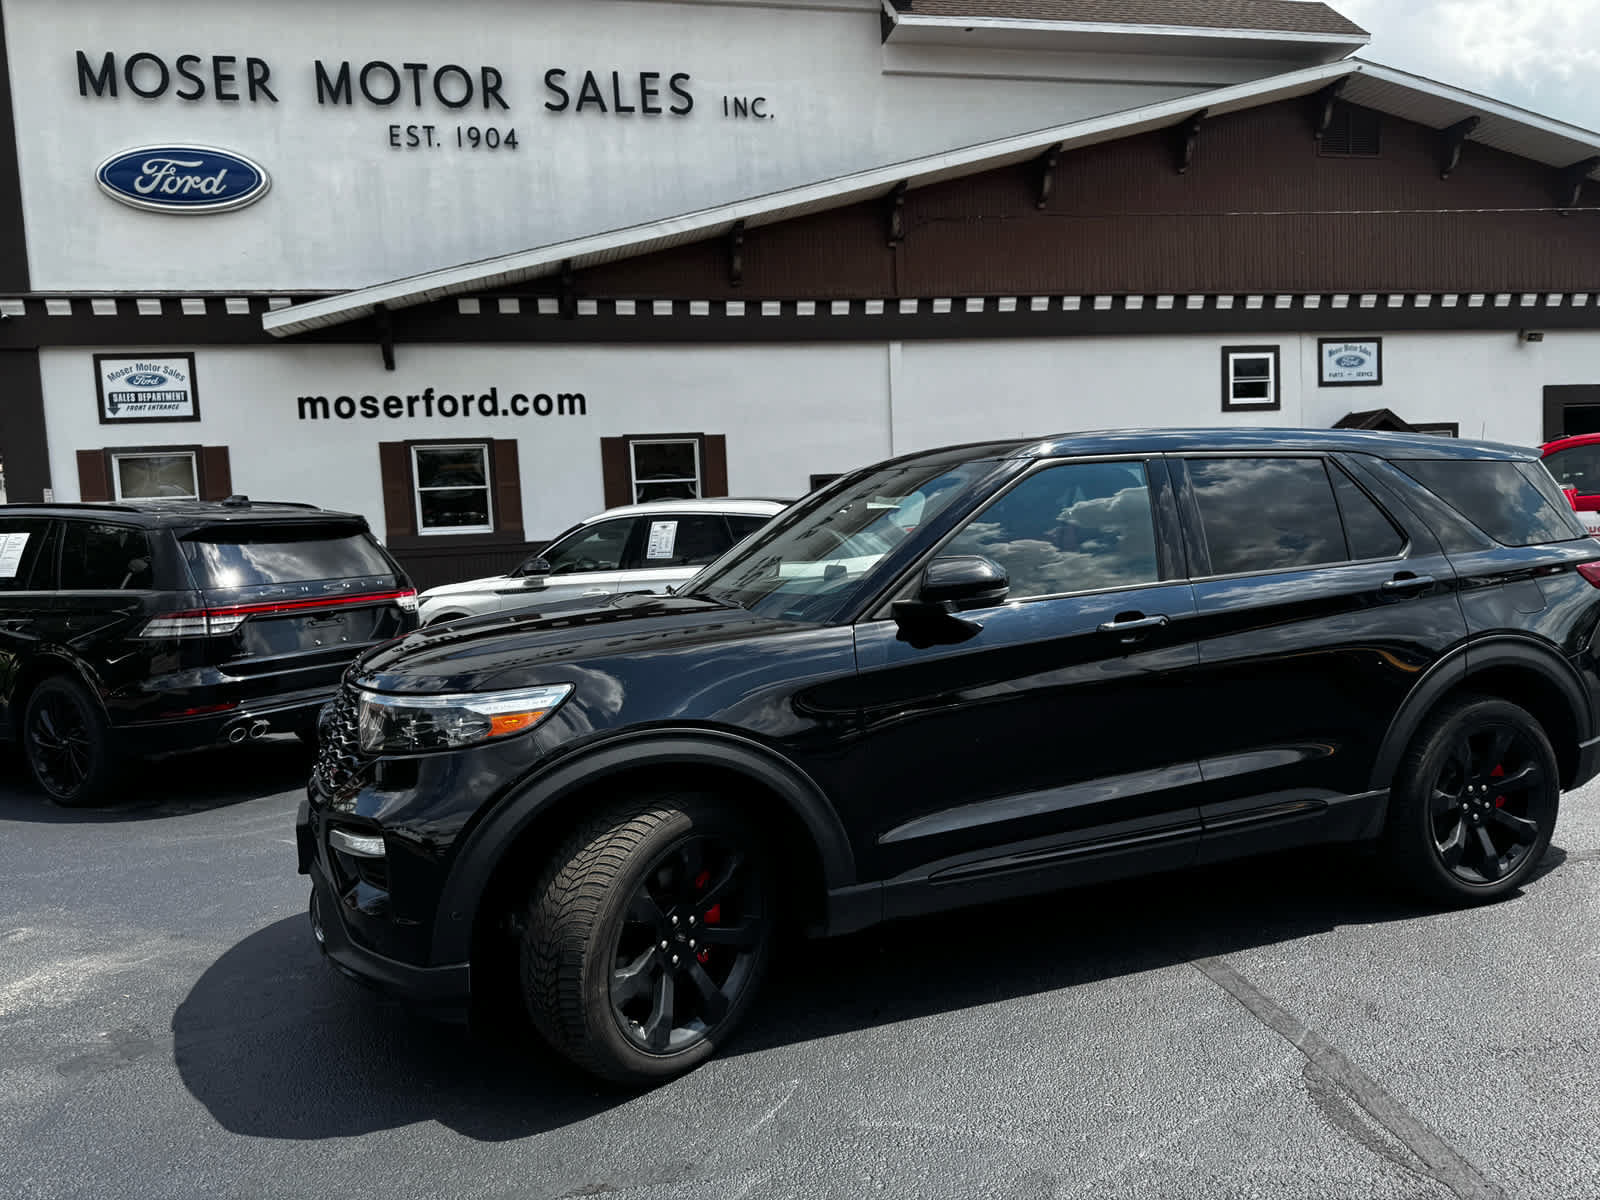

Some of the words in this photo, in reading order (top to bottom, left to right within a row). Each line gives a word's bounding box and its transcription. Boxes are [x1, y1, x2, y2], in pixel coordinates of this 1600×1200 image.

[77, 51, 278, 103] MOSER
[314, 60, 510, 111] MOTOR
[544, 69, 694, 117] SALES
[723, 95, 775, 119] INC.
[389, 125, 441, 148] EST.
[456, 126, 519, 150] 1904
[133, 157, 228, 195] Ford
[107, 365, 133, 382] Moser
[136, 362, 161, 372] Motor
[162, 365, 186, 382] Sales
[112, 393, 136, 403] SALES
[137, 391, 185, 402] DEPARTMENT
[148, 403, 180, 411] ENTRANCE
[297, 386, 587, 420] moserford.com
